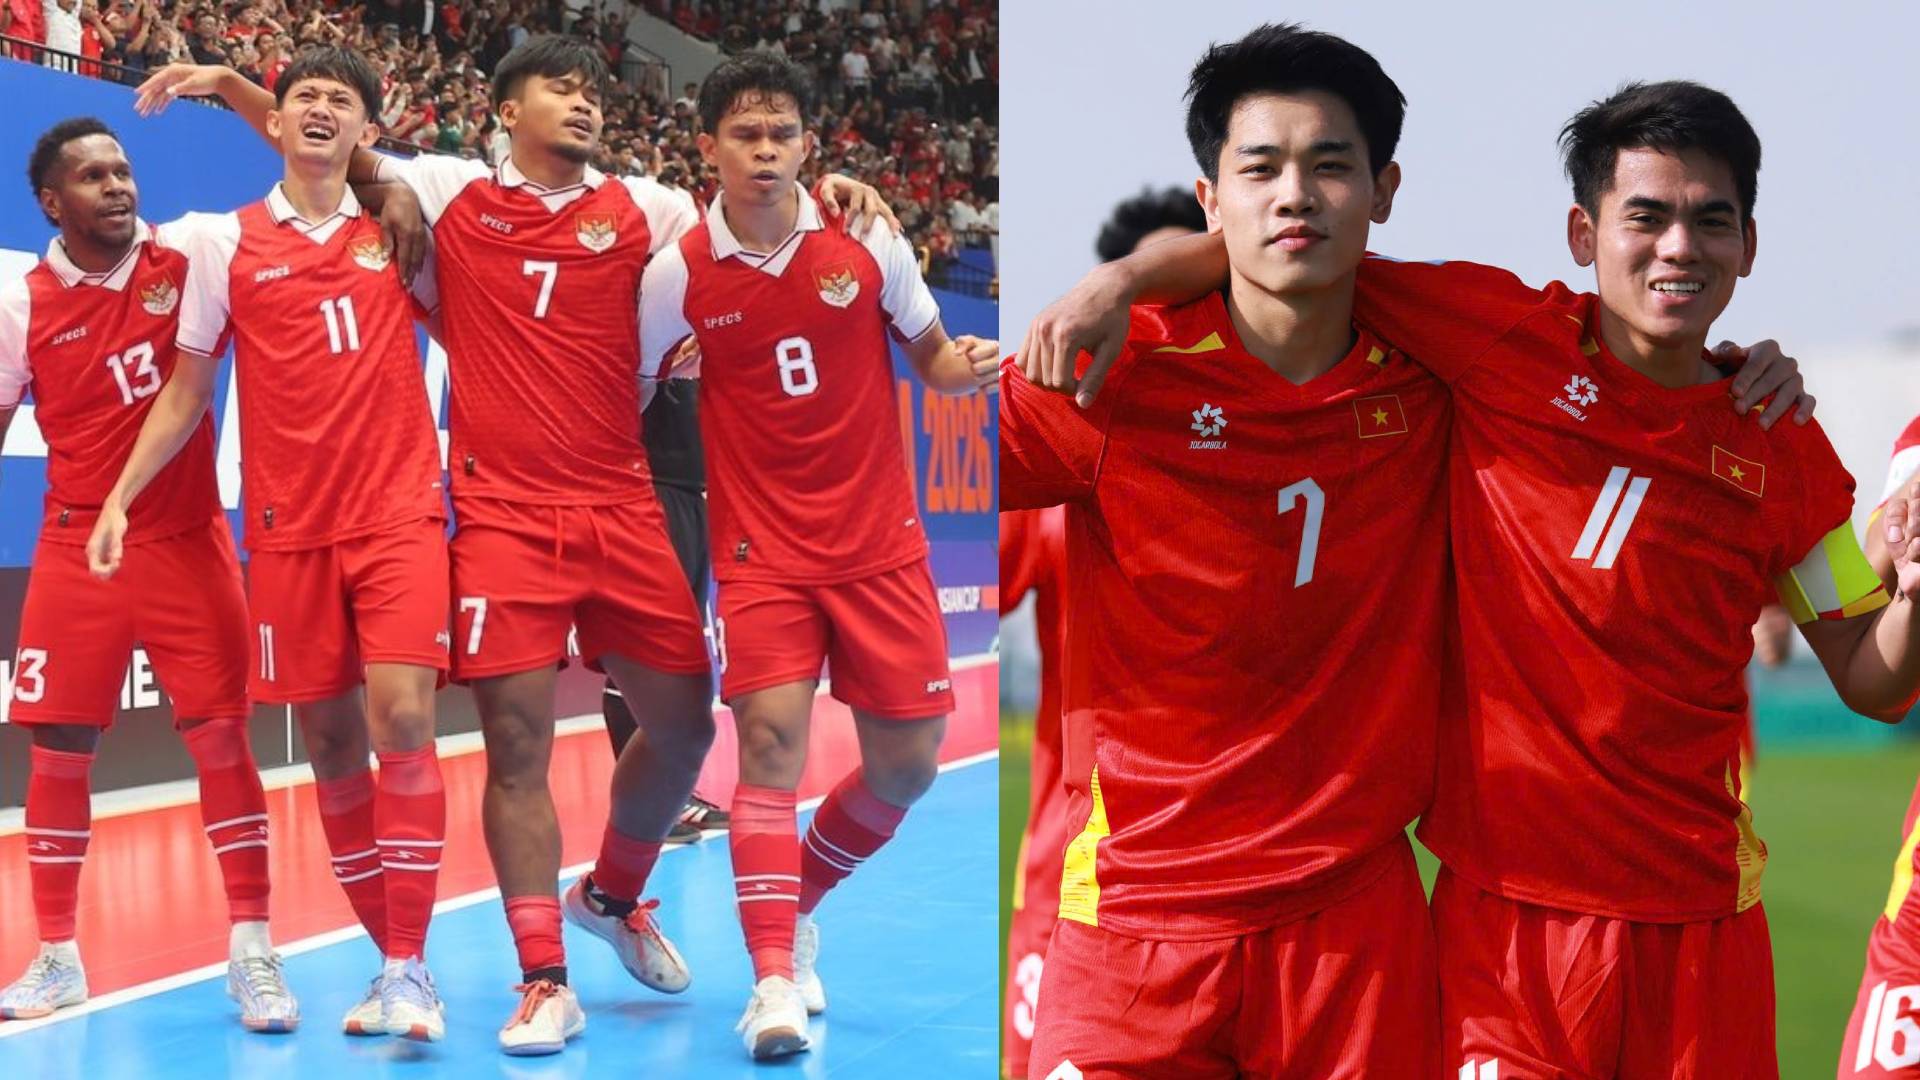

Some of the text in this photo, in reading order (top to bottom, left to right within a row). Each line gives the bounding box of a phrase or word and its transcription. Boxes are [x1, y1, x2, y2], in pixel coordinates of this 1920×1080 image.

[479, 213, 514, 234] SPECS
[523, 260, 558, 318] 7
[51, 326, 87, 346] SPECS
[320, 295, 360, 354] 11
[704, 311, 743, 329] SPECS
[106, 341, 162, 406] 13
[775, 336, 819, 397] 8
[923, 385, 993, 513] 2026
[1278, 476, 1326, 589] 7
[1570, 465, 1653, 570] 11
[259, 623, 275, 682] 11
[460, 597, 487, 655] 7
[1854, 979, 1920, 1073] 16
